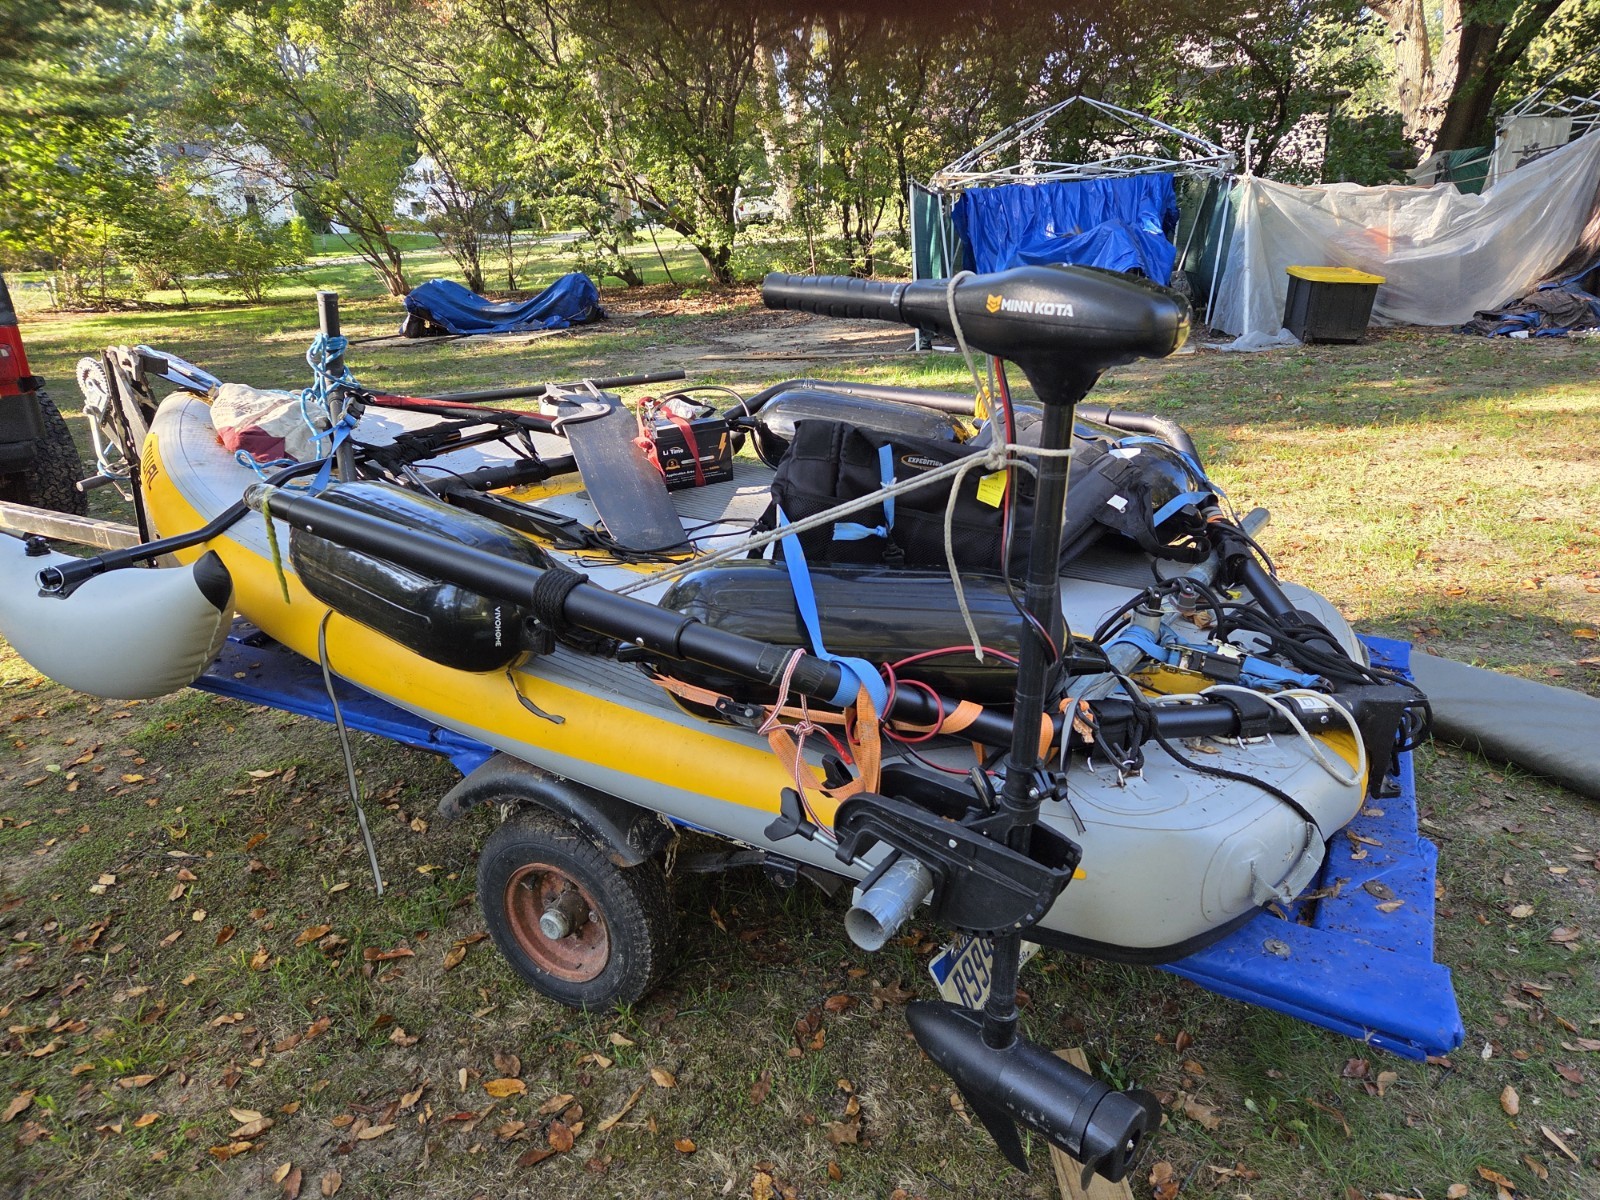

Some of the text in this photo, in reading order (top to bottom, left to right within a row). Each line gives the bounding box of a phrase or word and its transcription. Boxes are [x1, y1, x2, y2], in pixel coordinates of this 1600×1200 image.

[1001, 298, 1074, 317] MINN KOTA
[494, 606, 502, 647] VIVOHOME
